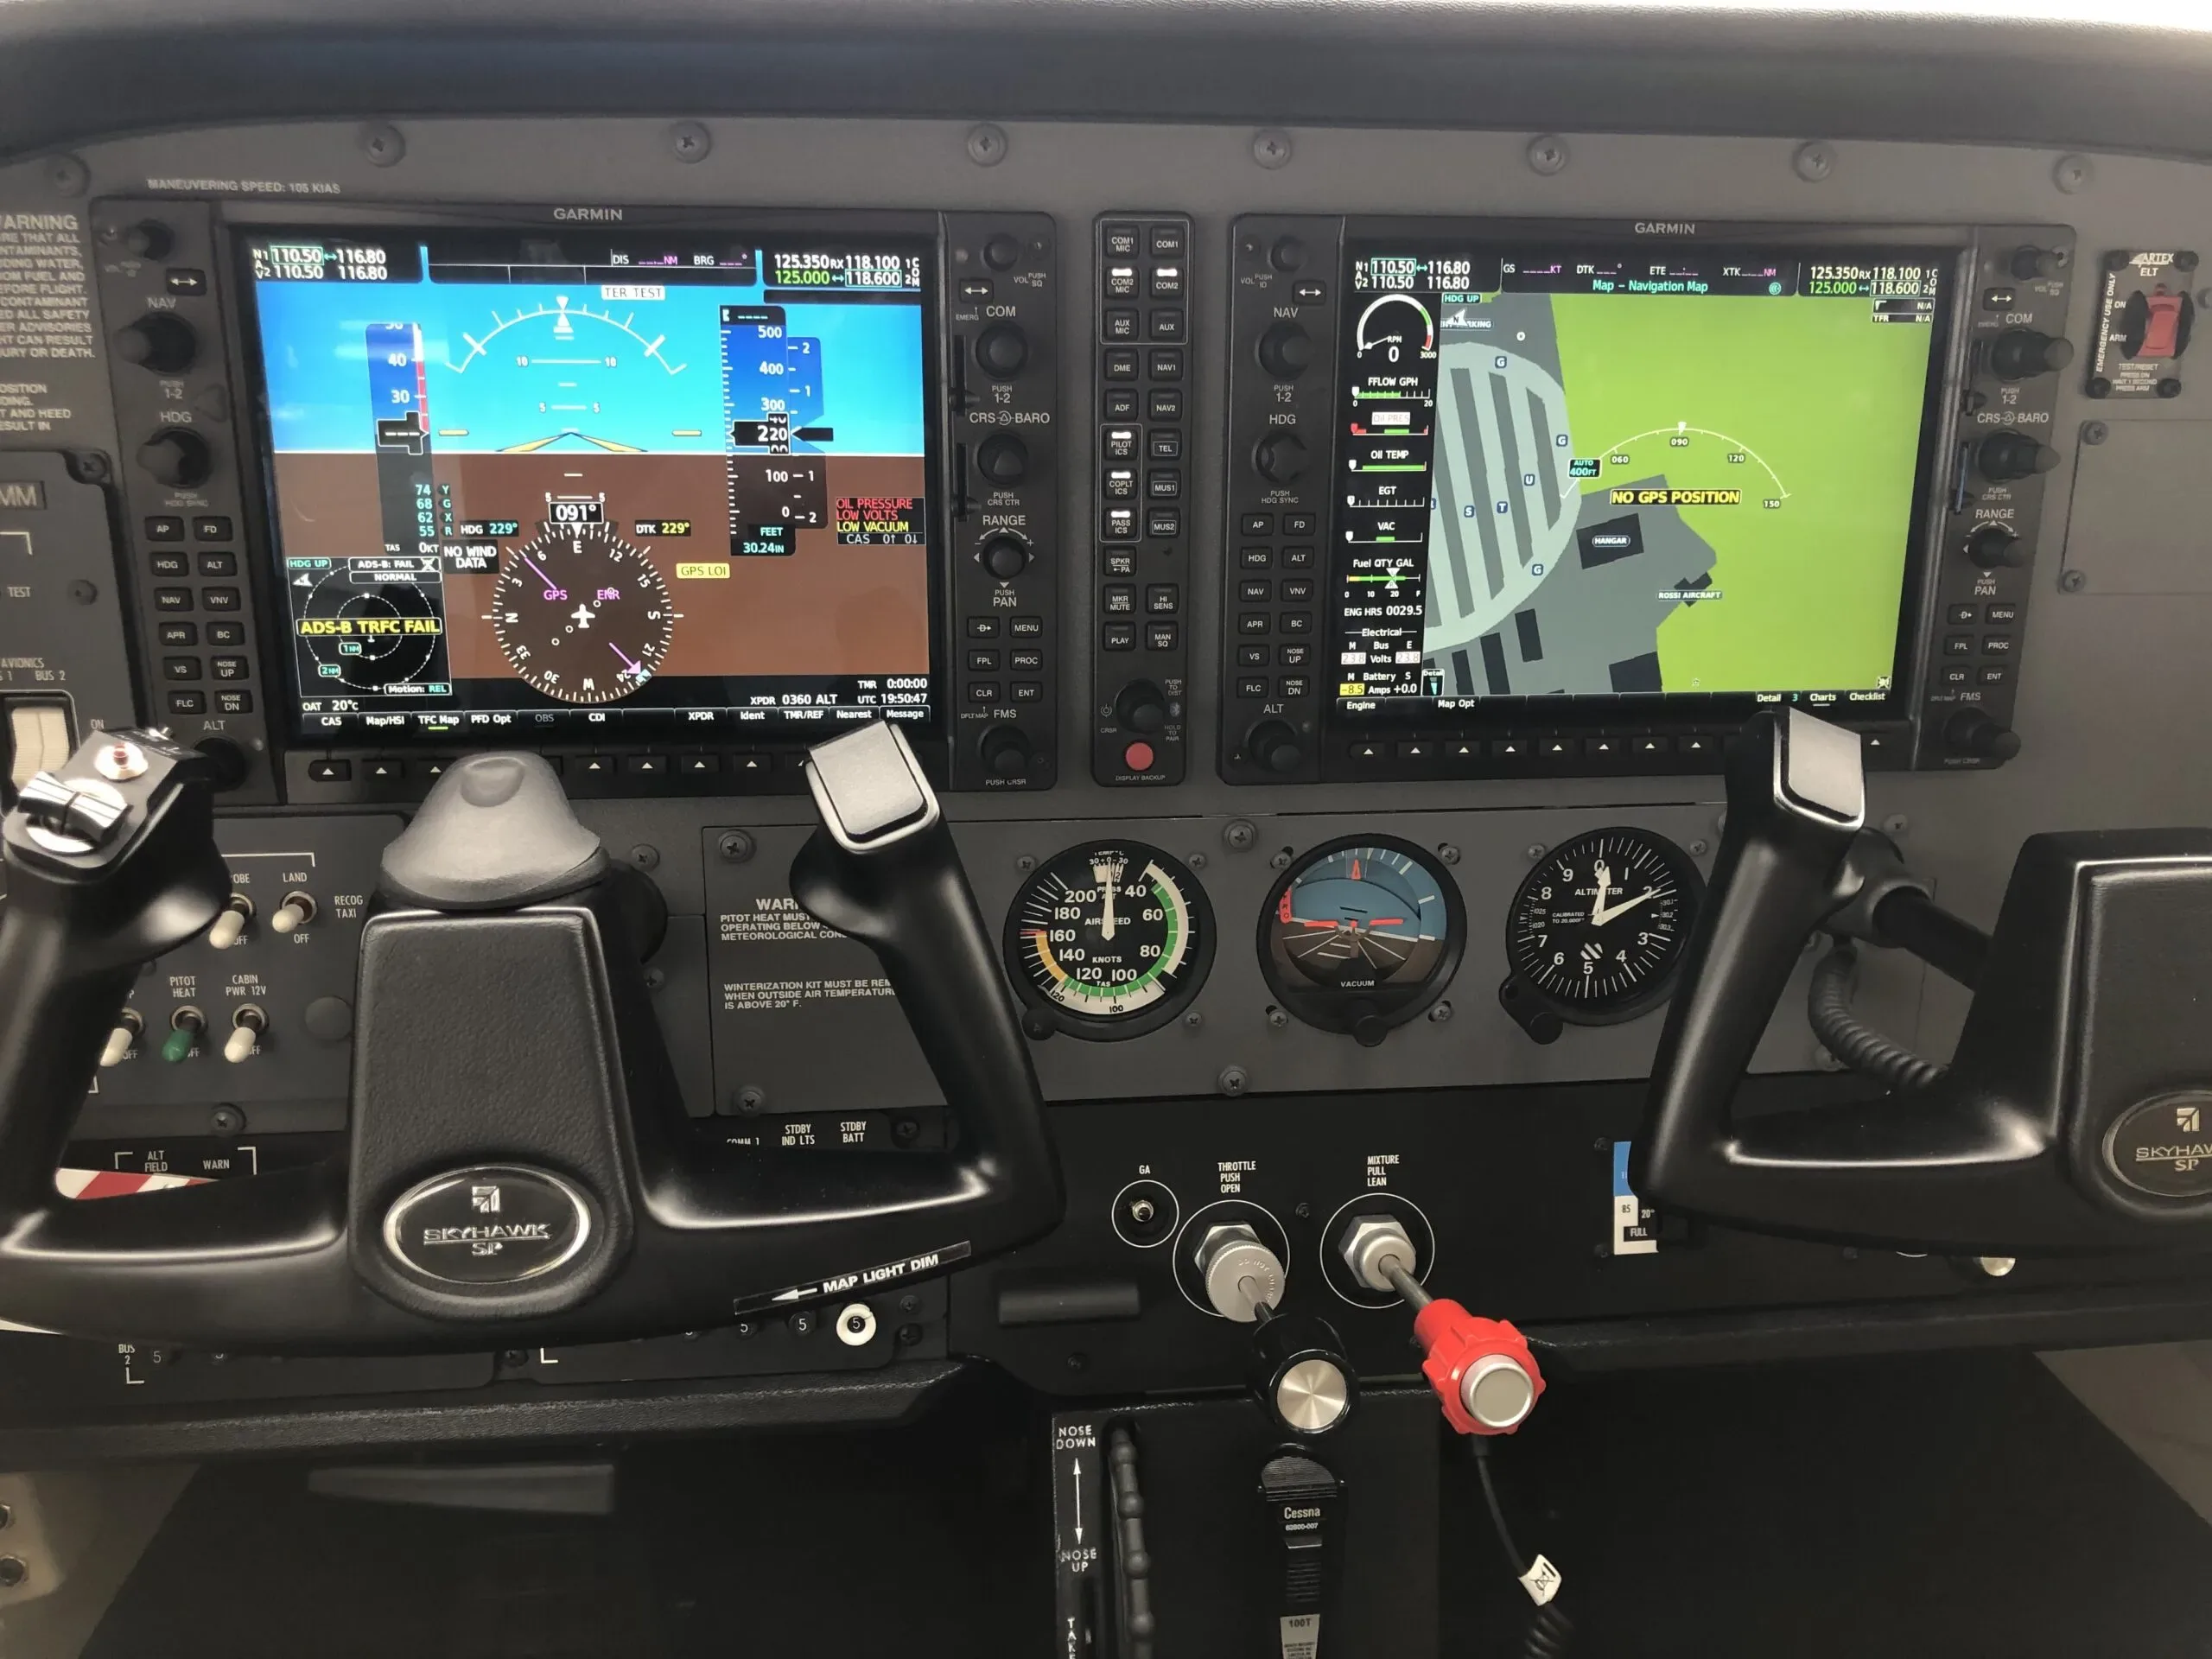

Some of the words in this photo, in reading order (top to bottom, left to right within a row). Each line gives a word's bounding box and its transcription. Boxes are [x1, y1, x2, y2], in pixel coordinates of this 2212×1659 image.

[147, 179, 238, 192] MANEUVERING
[240, 181, 285, 193] SPEED:
[312, 182, 340, 194] KIAS
[553, 207, 624, 221] GARMIN
[1635, 222, 1695, 234] GARMIN
[272, 248, 321, 264] 110.50
[337, 250, 385, 264] 116.80
[694, 256, 714, 265] BRG
[775, 255, 830, 269] 125.350
[846, 256, 900, 270] 118.100
[1372, 261, 1414, 274] 110.50
[1427, 262, 1470, 274] 116.80
[275, 265, 323, 278] 110.50
[339, 266, 387, 280] 116.80
[776, 271, 830, 284] 125.000
[847, 271, 900, 285] 118.600
[1372, 276, 1414, 289] 110.50
[1427, 276, 1470, 289] 116.80
[1592, 281, 1614, 292] Map
[1629, 281, 1682, 294] Navigation
[1686, 282, 1707, 294] Map
[605, 288, 626, 298] TER
[633, 288, 662, 298] TEST
[43, 310, 89, 320] SAFETY
[987, 306, 1016, 317] COM
[1274, 308, 1298, 318] NAV
[2096, 318, 2110, 372] EMERGENCY
[2107, 273, 2116, 296] ONLY
[758, 326, 782, 338] 500
[46, 335, 93, 345] RESULT
[760, 363, 784, 375] 400
[1369, 378, 1395, 386] FFLOW
[1399, 378, 1418, 386] GPH
[969, 413, 995, 423] CRS
[1014, 413, 1050, 423] BARO
[1379, 486, 1396, 495] EGT
[1611, 491, 1631, 503] NO
[1638, 491, 1667, 503] GPS
[1672, 491, 1740, 503] POSITION
[836, 499, 854, 509] OIL
[857, 499, 912, 509] PRESSURE
[836, 511, 860, 520] LOW
[864, 511, 899, 520] VOLTS
[1975, 510, 2015, 518] RANGE
[982, 515, 1026, 525] RANGE
[461, 525, 483, 534] HDG
[636, 524, 656, 534] DTK
[760, 527, 783, 536] FEET
[836, 522, 861, 532] LOW
[865, 522, 909, 532] VACUUM
[444, 546, 463, 556] NO
[467, 546, 496, 556] WIND
[456, 558, 487, 569] DATA
[681, 566, 704, 575] GPS
[374, 573, 416, 582] NORMAL
[8, 587, 31, 597] TEST
[1386, 606, 1422, 615] 0029.5
[301, 622, 352, 634] ADS-B
[358, 621, 401, 633] TRFC
[404, 621, 439, 632] FAIL
[858, 680, 877, 689] TMR
[887, 678, 927, 689] 0:00:00
[389, 684, 425, 694] Motion:
[429, 684, 446, 693] REL
[782, 695, 811, 705] 0360
[816, 694, 837, 704] ALT
[858, 695, 876, 703] UTC
[881, 694, 927, 704] 19:50:47
[1809, 692, 1836, 702] Charts
[1849, 691, 1885, 702] Checklist
[1347, 702, 1376, 710] Engine
[689, 711, 714, 721] XPDR
[741, 711, 765, 720] Ident
[784, 710, 823, 719] TMR/REF
[836, 709, 871, 719] Nearest
[887, 709, 924, 719] Message
[366, 716, 404, 726] Map/HSI
[418, 715, 436, 724] TFC
[440, 715, 459, 726] Map
[471, 715, 489, 724] PFD
[493, 715, 512, 724] Opt
[283, 873, 307, 882] LAND
[334, 895, 363, 906] RECOG
[1065, 891, 1096, 903] 200
[335, 909, 356, 918] TAXI
[1143, 910, 1163, 920] 60
[721, 923, 780, 931] OPERATING
[721, 931, 817, 940] METEOROLOGICAL
[1050, 930, 1075, 942] 160
[1140, 945, 1160, 957] 80
[1077, 968, 1102, 979] 120
[1112, 969, 1137, 981] 100
[170, 976, 195, 985] PITOT
[232, 975, 258, 983] CABIN
[724, 982, 804, 991] WINTERIZATION
[173, 988, 195, 997] HEAT
[843, 1133, 864, 1142] BATT
[203, 1160, 229, 1170] WARN
[1367, 1155, 1399, 1165] MIXTURE
[1139, 1166, 1150, 1174] GA
[1218, 1161, 1255, 1171] THROTTLE
[1367, 1177, 1387, 1186] LEAN
[424, 1224, 550, 1241] SKYHAWK
[1630, 1228, 1647, 1236] FULL
[823, 1276, 857, 1293] MAP
[863, 1263, 905, 1283] LIGHT
[911, 1254, 938, 1271] DIM
[1058, 1425, 1092, 1437] NOSE
[1056, 1437, 1096, 1450] DOWN
[1284, 1507, 1320, 1519] Cessna
